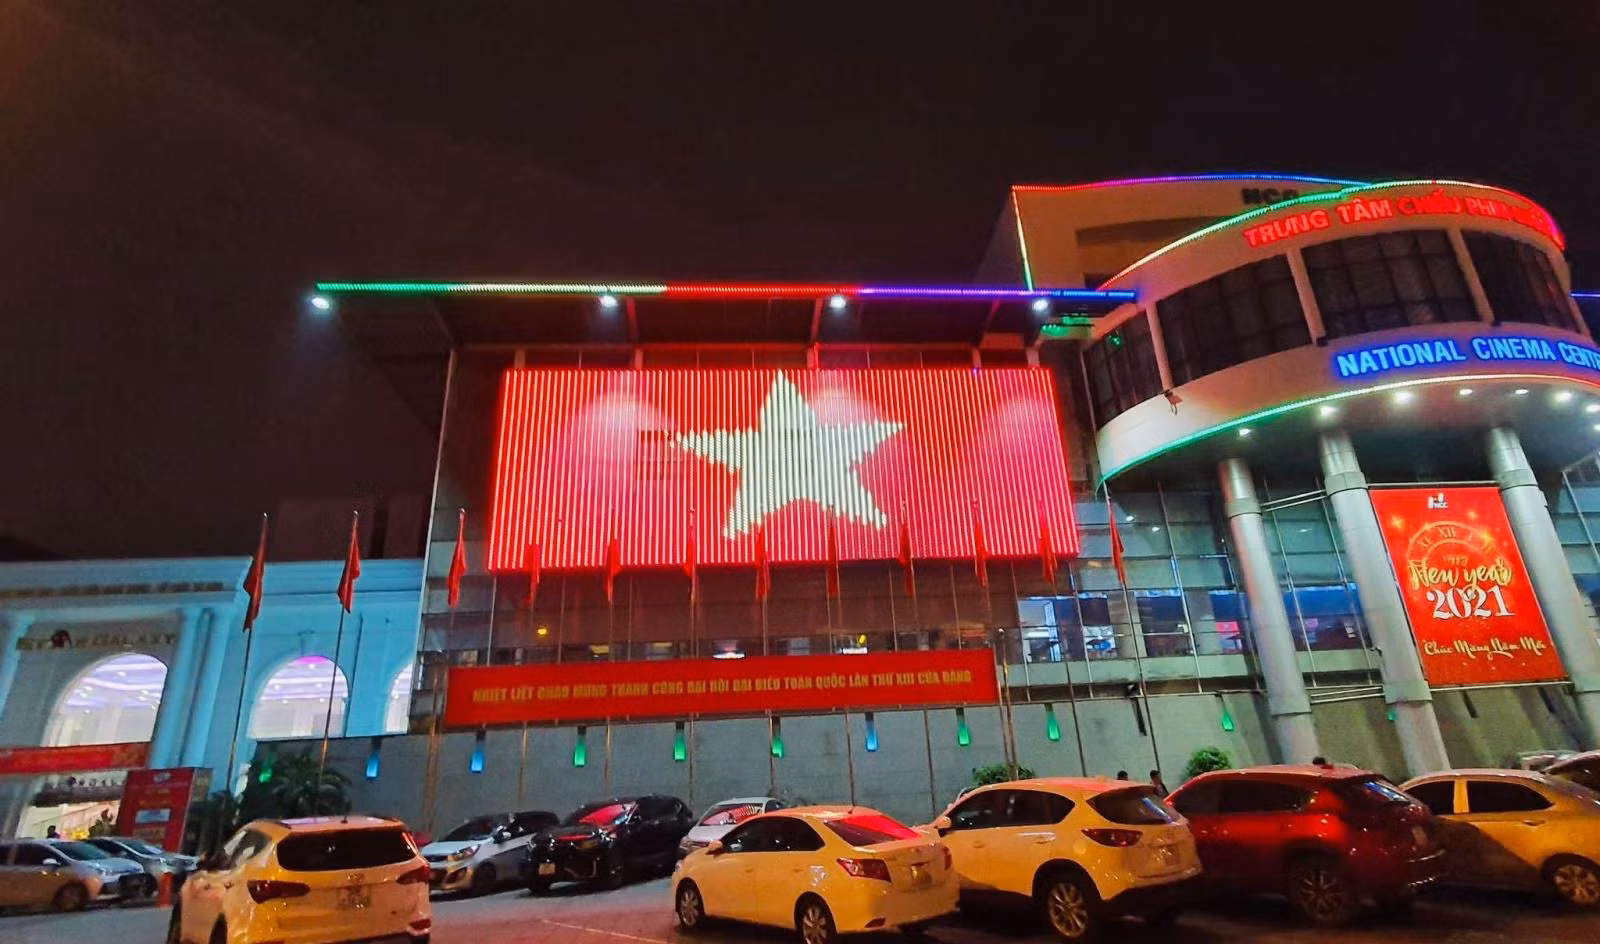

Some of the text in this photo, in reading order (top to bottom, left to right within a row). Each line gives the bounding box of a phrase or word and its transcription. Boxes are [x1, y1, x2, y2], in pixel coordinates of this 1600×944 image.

[1244, 210, 1329, 247] TRUNG
[1336, 198, 1393, 223] TÂM
[1337, 340, 1466, 376] NATIONAL
[1472, 338, 1556, 361] CINEMA
[1408, 557, 1459, 591] New
[1426, 585, 1516, 619] 2021
